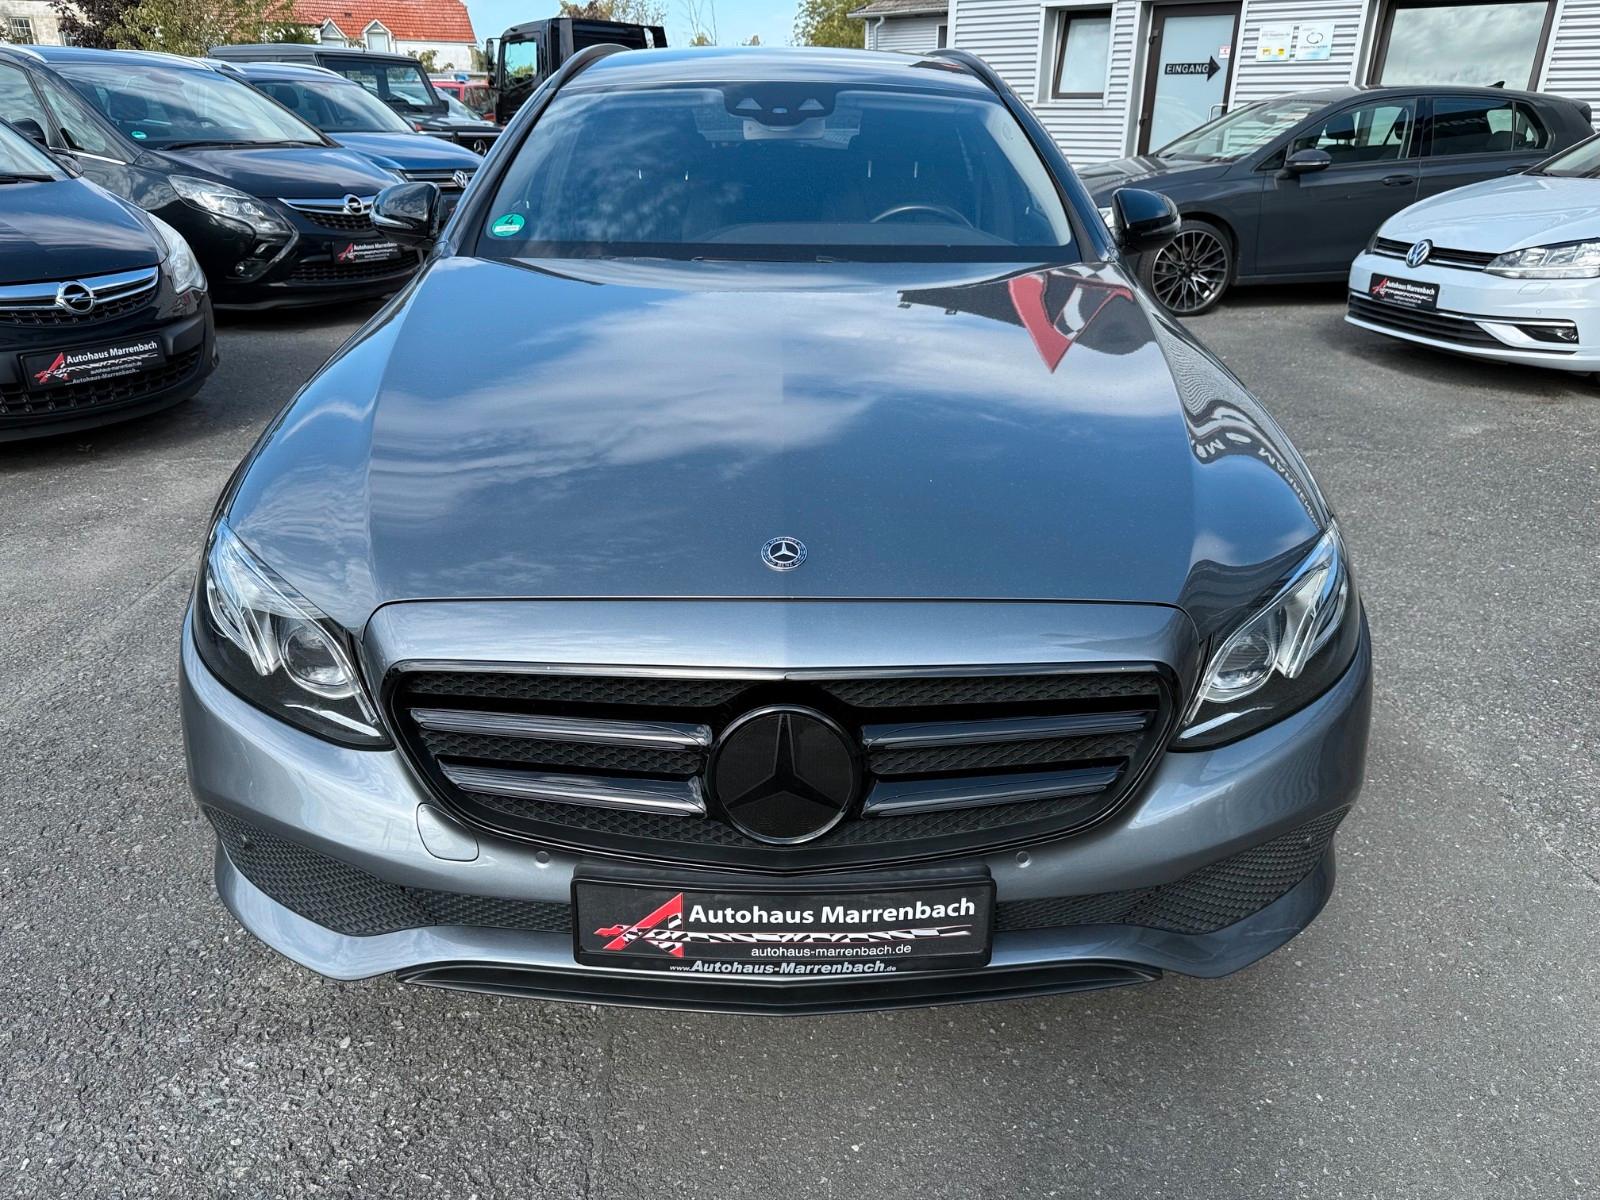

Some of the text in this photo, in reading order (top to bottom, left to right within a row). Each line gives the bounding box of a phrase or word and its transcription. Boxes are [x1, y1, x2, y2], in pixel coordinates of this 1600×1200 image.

[1166, 63, 1209, 75] EINGANG
[504, 214, 514, 225] 4
[66, 341, 158, 364] Autohaus Marrenbach
[688, 897, 975, 924] Autohaus Marrenbach
[751, 944, 912, 957] autohaus-marrenbach.de
[669, 960, 897, 974] www.Autohaus-Marrenbach.de
